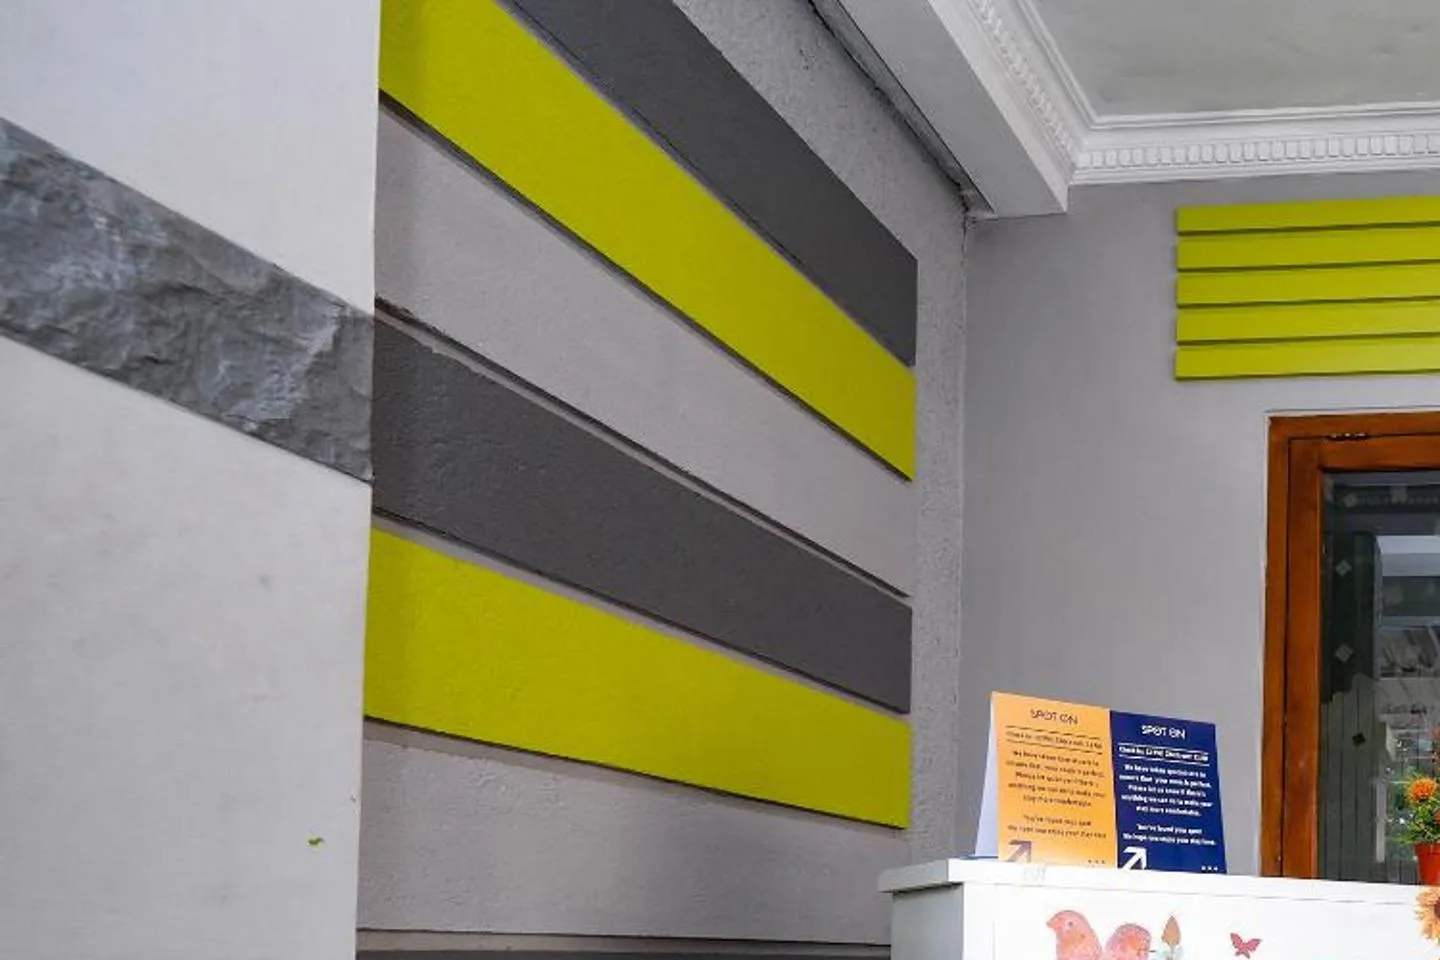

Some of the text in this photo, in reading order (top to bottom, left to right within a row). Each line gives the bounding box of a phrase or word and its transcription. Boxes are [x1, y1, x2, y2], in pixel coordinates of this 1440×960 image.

[1030, 708, 1079, 725] SPOT ON
[1141, 724, 1186, 739] SPOT ON
